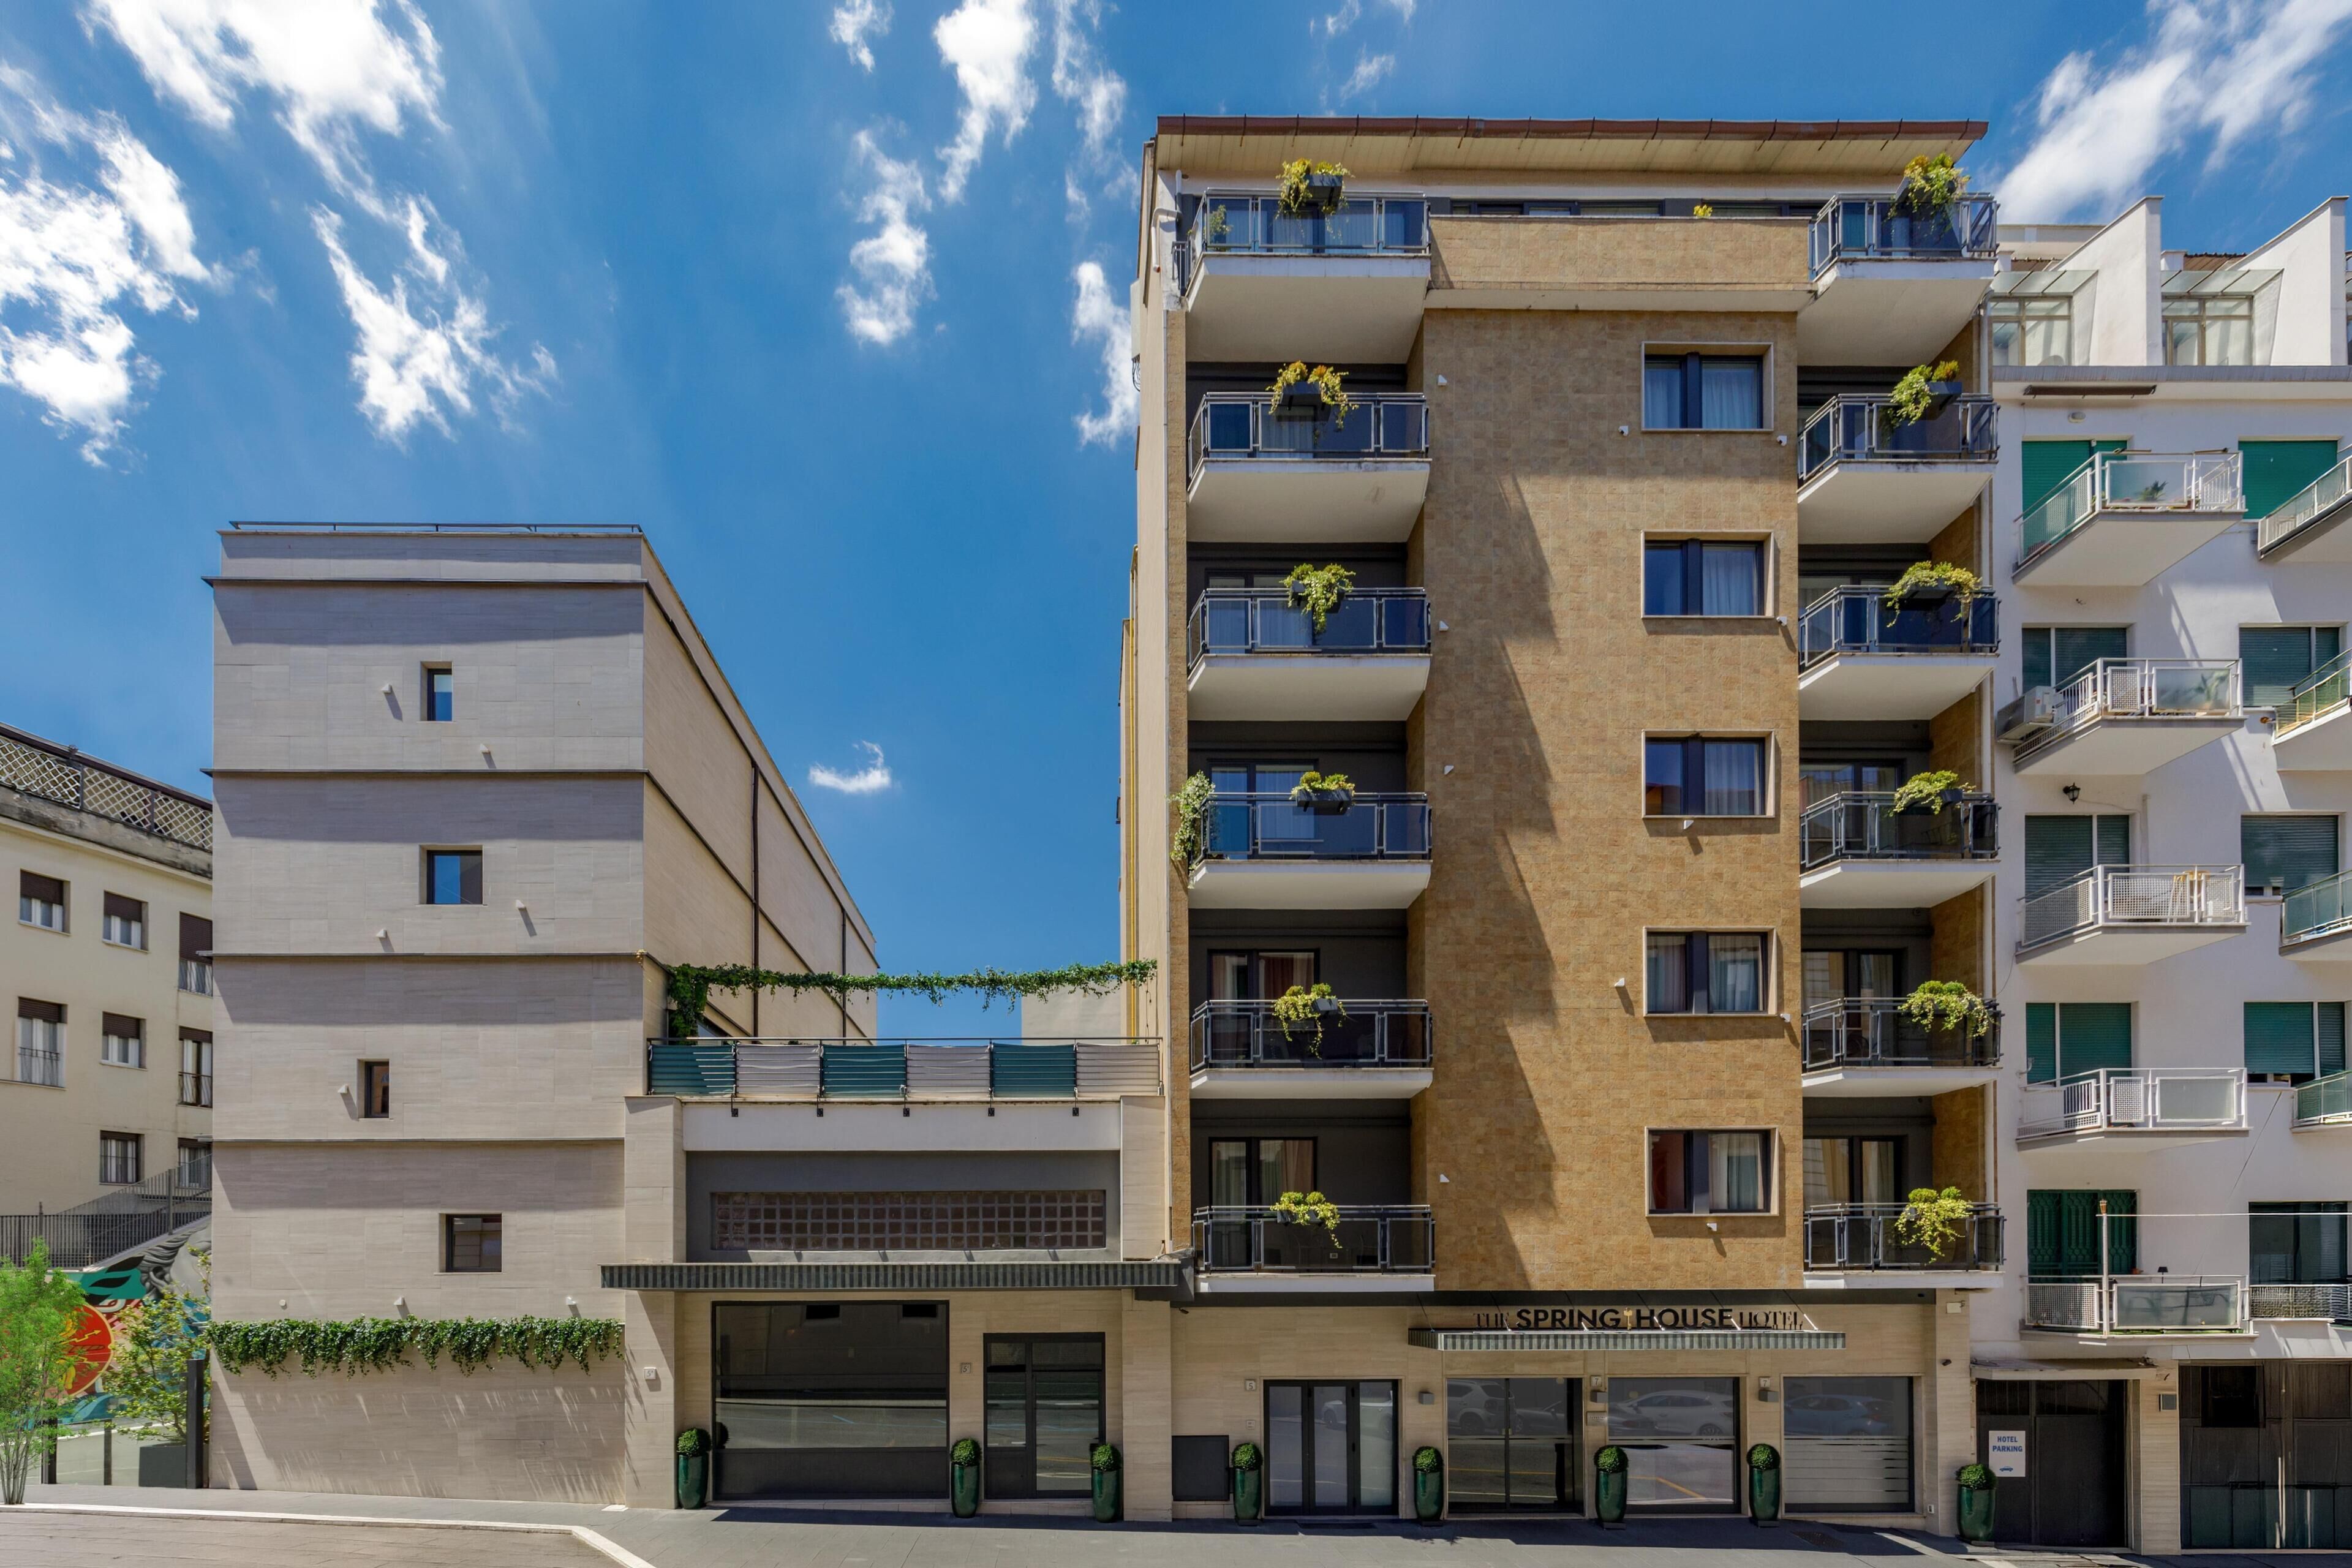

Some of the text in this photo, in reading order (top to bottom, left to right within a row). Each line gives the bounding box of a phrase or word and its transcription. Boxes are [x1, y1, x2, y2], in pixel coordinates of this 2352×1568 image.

[1515, 1308, 1621, 1329] SPRING
[1636, 1308, 1733, 1329] HOUSE
[1739, 1311, 1803, 1330] HOTEL
